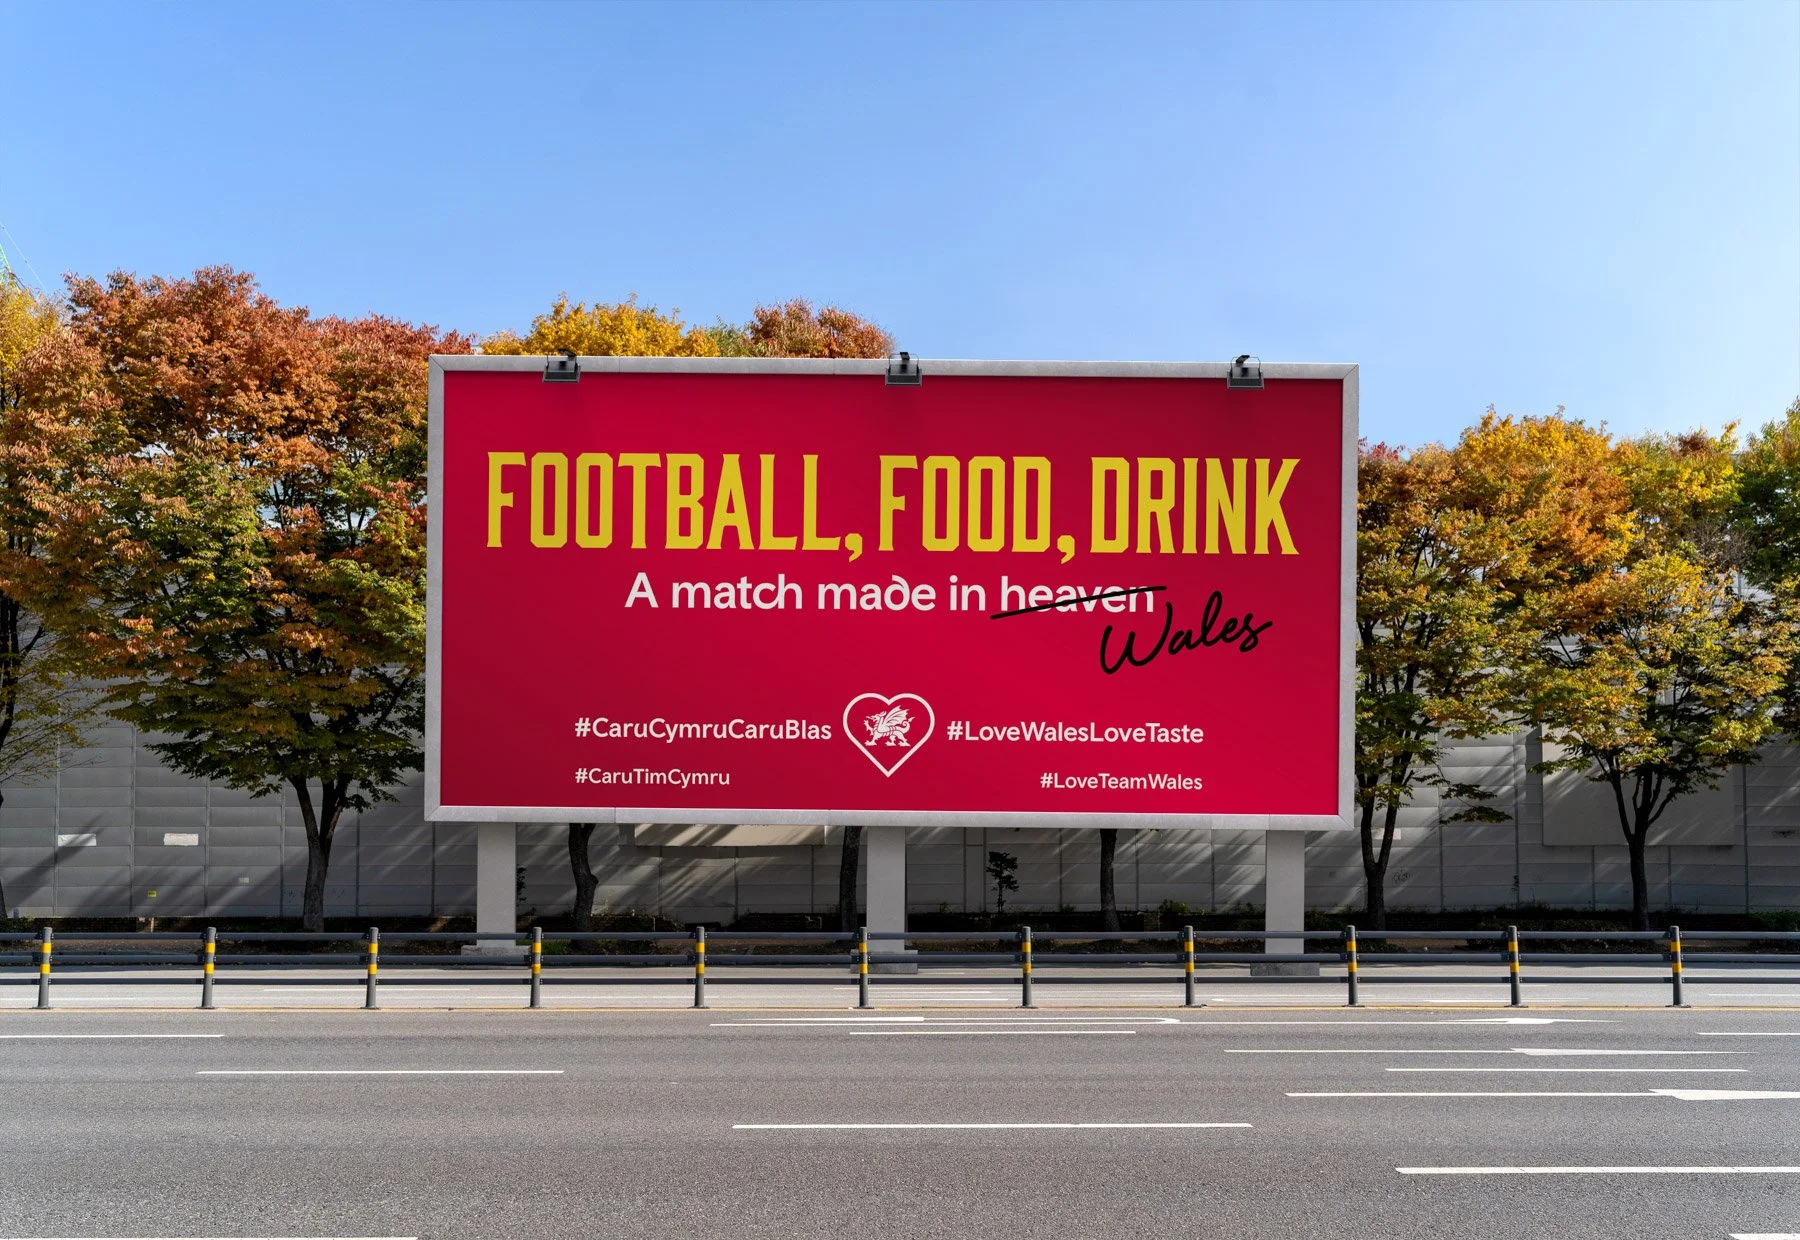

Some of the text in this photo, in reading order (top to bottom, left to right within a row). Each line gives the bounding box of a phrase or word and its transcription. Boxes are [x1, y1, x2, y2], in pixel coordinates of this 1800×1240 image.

[487, 451, 1300, 564] FOOTBALL, FOOD, DRINK
[625, 572, 1153, 612] A match made in heaven
[1100, 590, 1273, 675] Wales
[574, 717, 832, 744] #CaruCymruCaruBlas
[946, 720, 1204, 744] #LoveWalesLoveTaste
[575, 767, 730, 789] #CaruTimCymru
[1040, 772, 1203, 790] #LoveTeamWales
